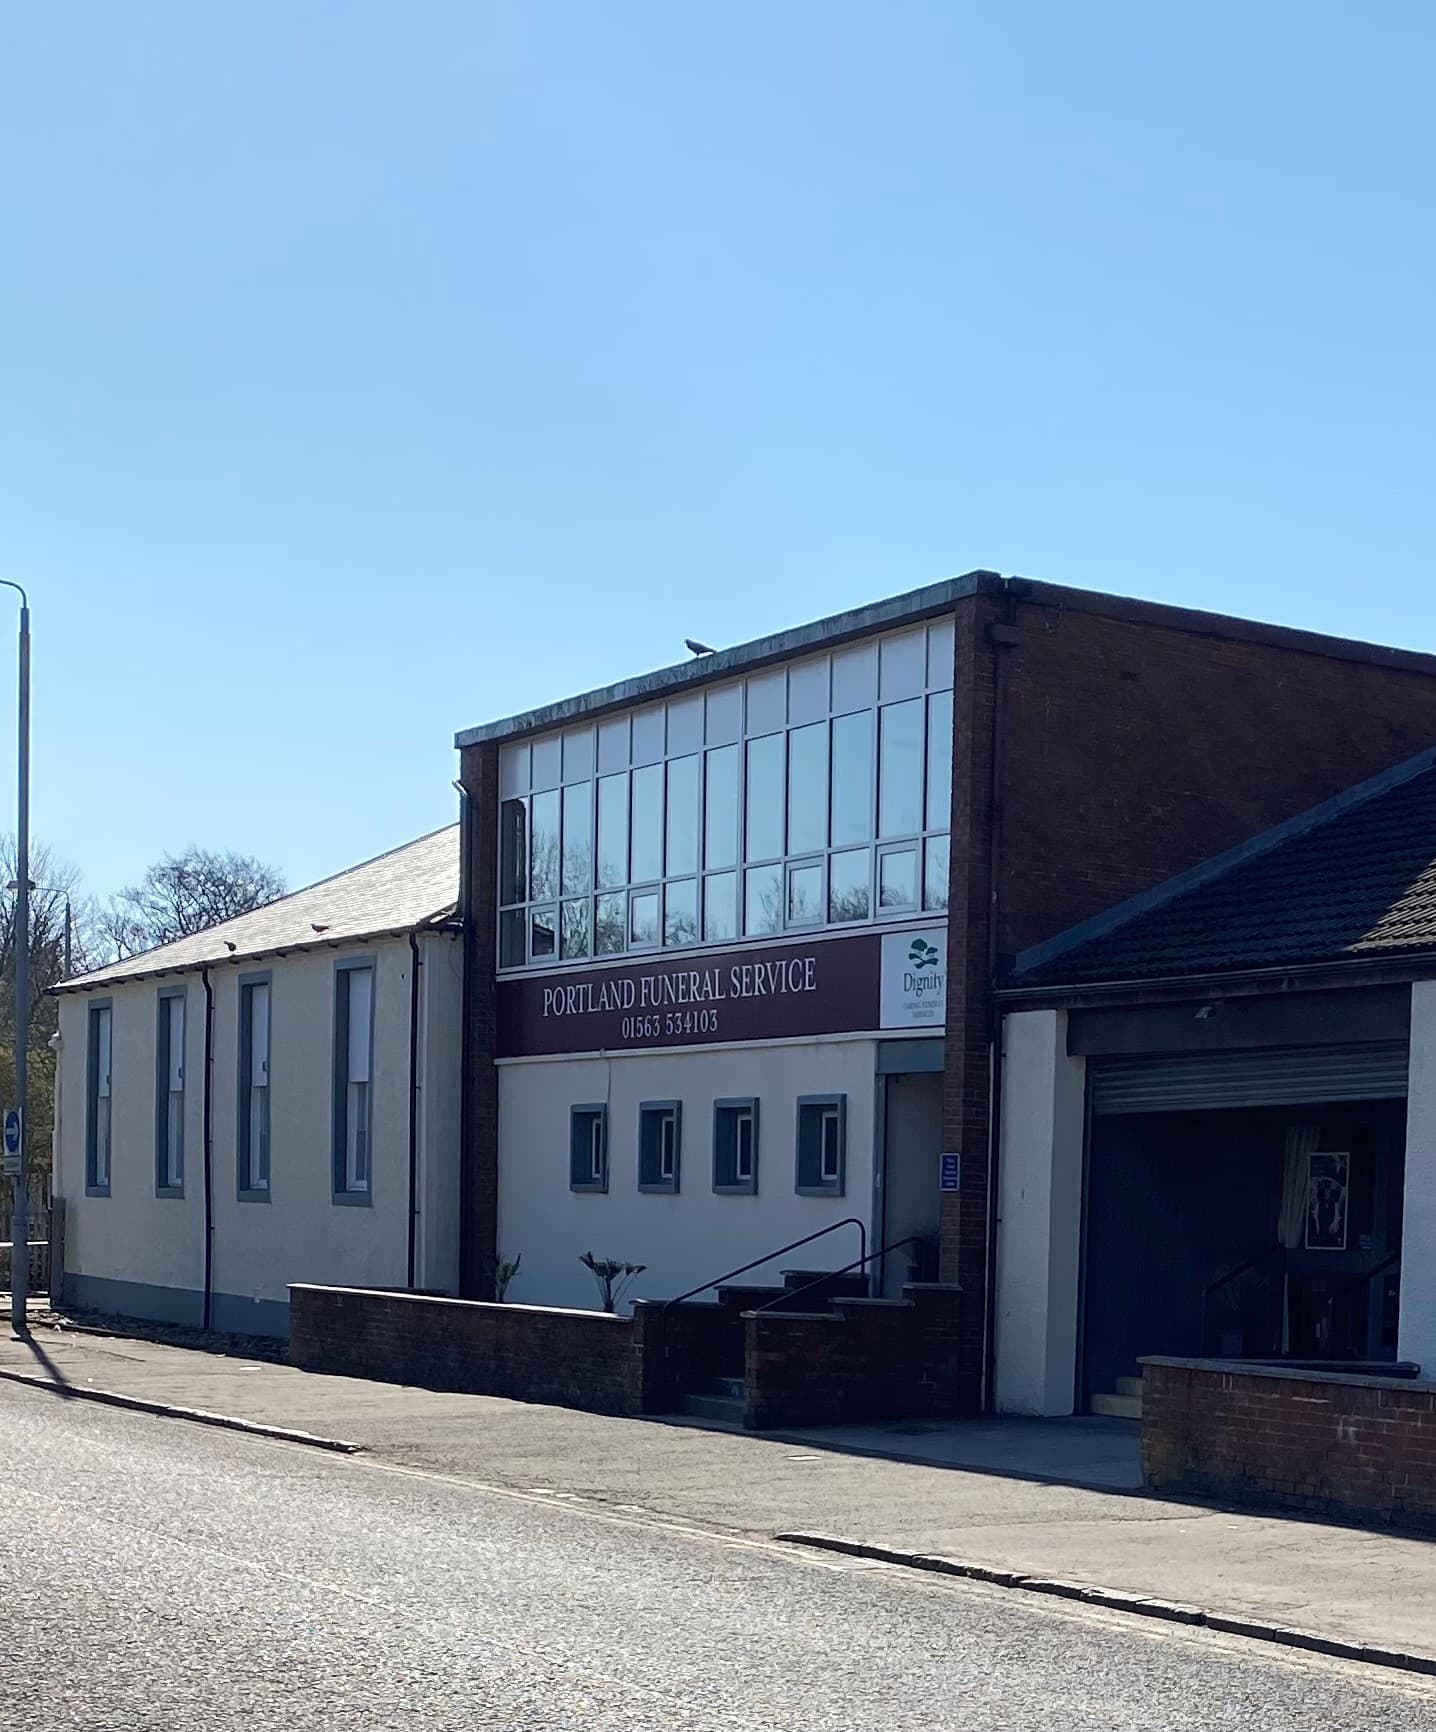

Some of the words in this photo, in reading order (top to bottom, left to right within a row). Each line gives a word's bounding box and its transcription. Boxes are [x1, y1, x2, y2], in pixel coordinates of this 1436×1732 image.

[543, 979, 635, 1016] PORTLAND
[640, 968, 725, 1007] FUNERAL
[730, 957, 816, 998] SERVICE
[903, 971, 944, 997] Dignity
[622, 1015, 660, 1039] 01563
[666, 1009, 718, 1035] 534103
